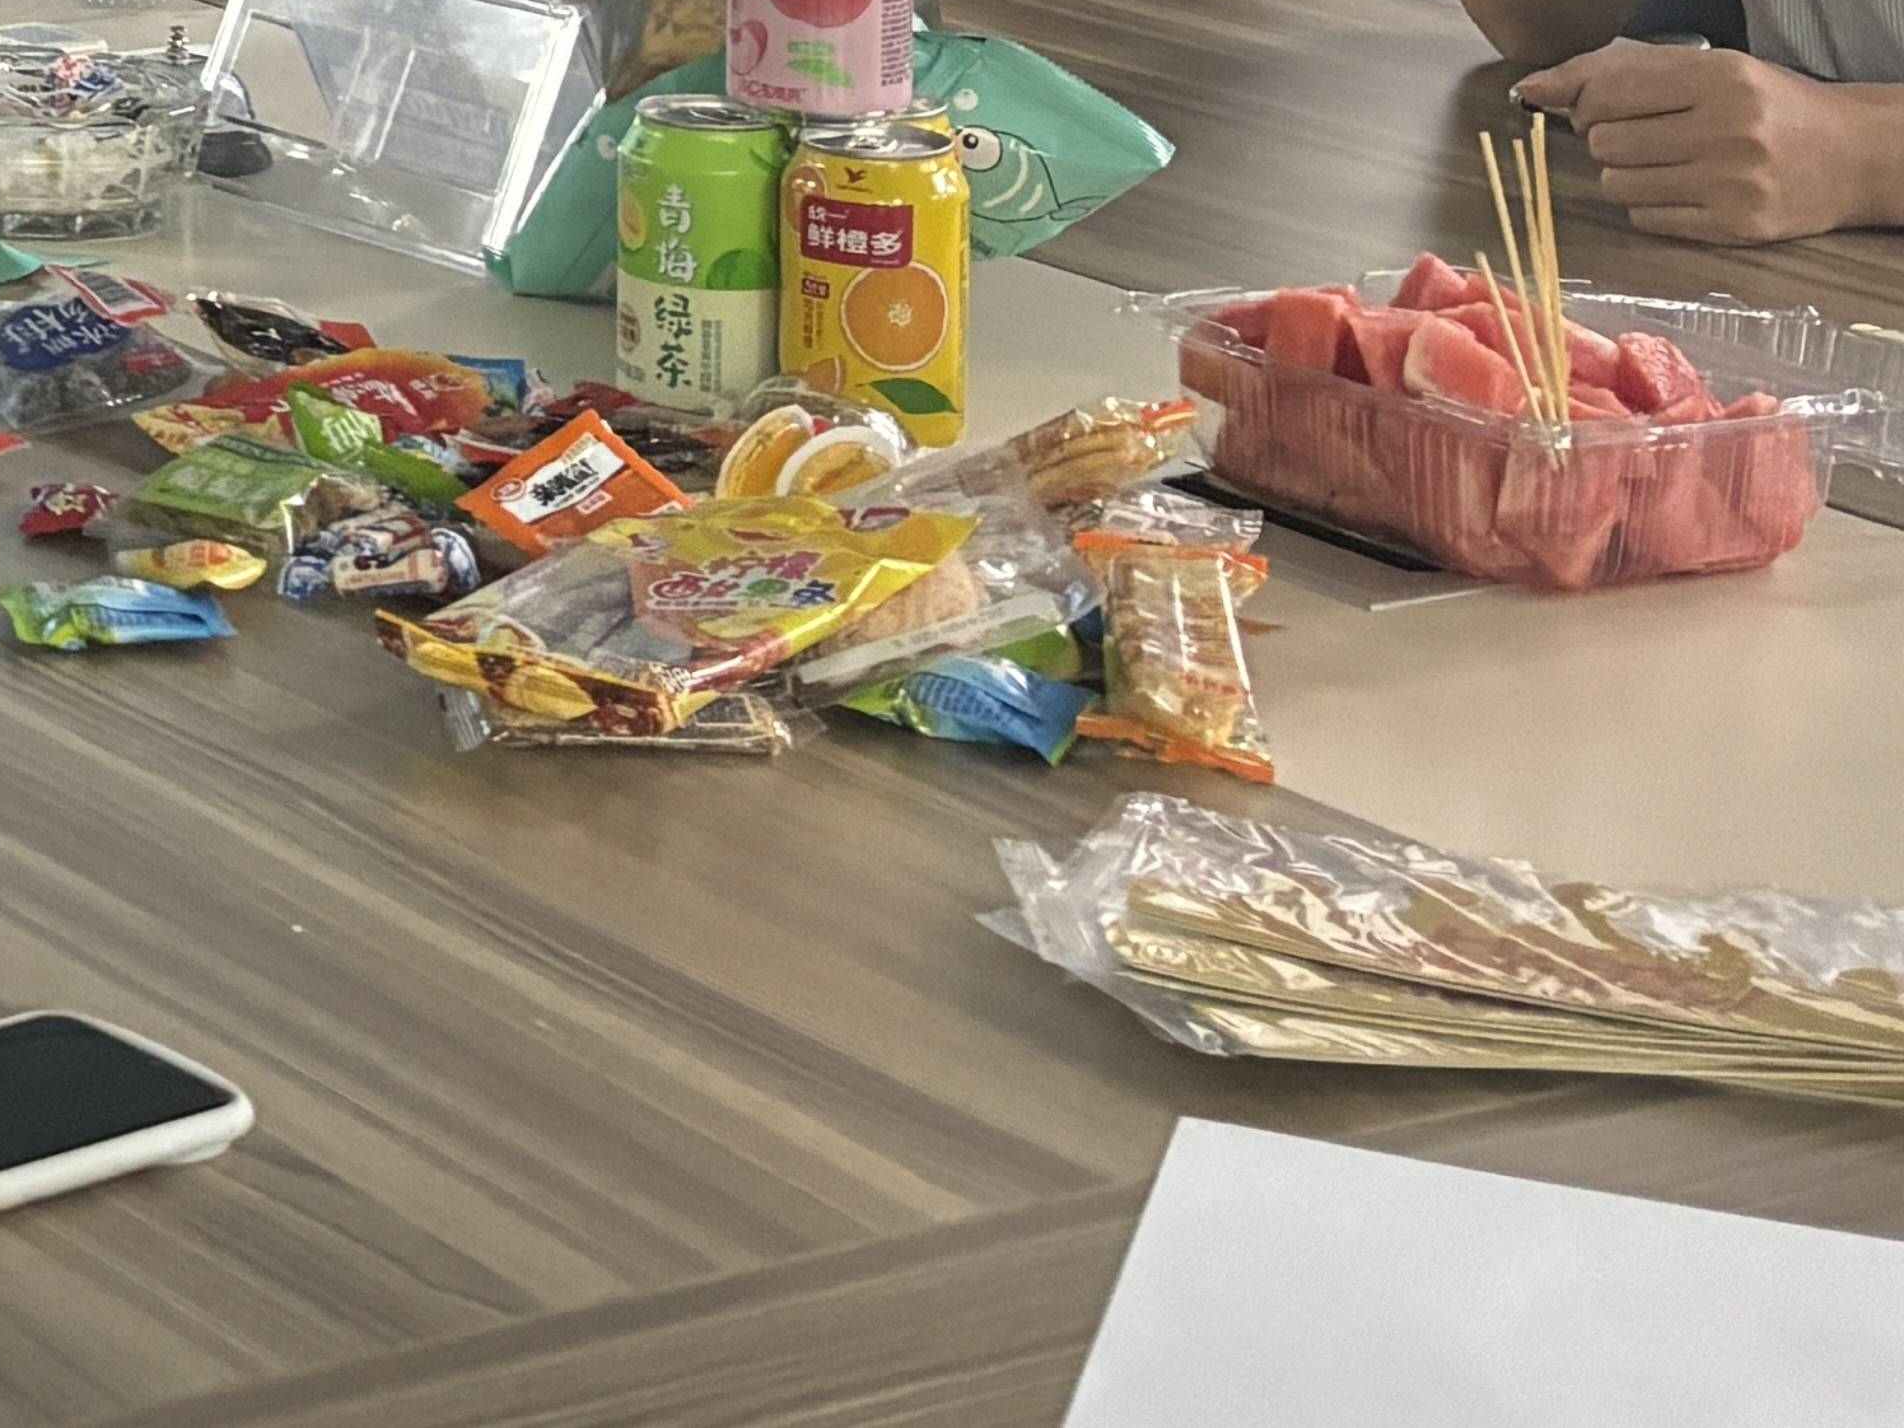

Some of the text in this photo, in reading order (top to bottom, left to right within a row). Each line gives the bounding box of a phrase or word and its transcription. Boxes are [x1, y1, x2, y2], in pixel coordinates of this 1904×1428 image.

[653, 182, 697, 390] 青梅绿茶
[806, 225, 903, 257] 鲜橙多
